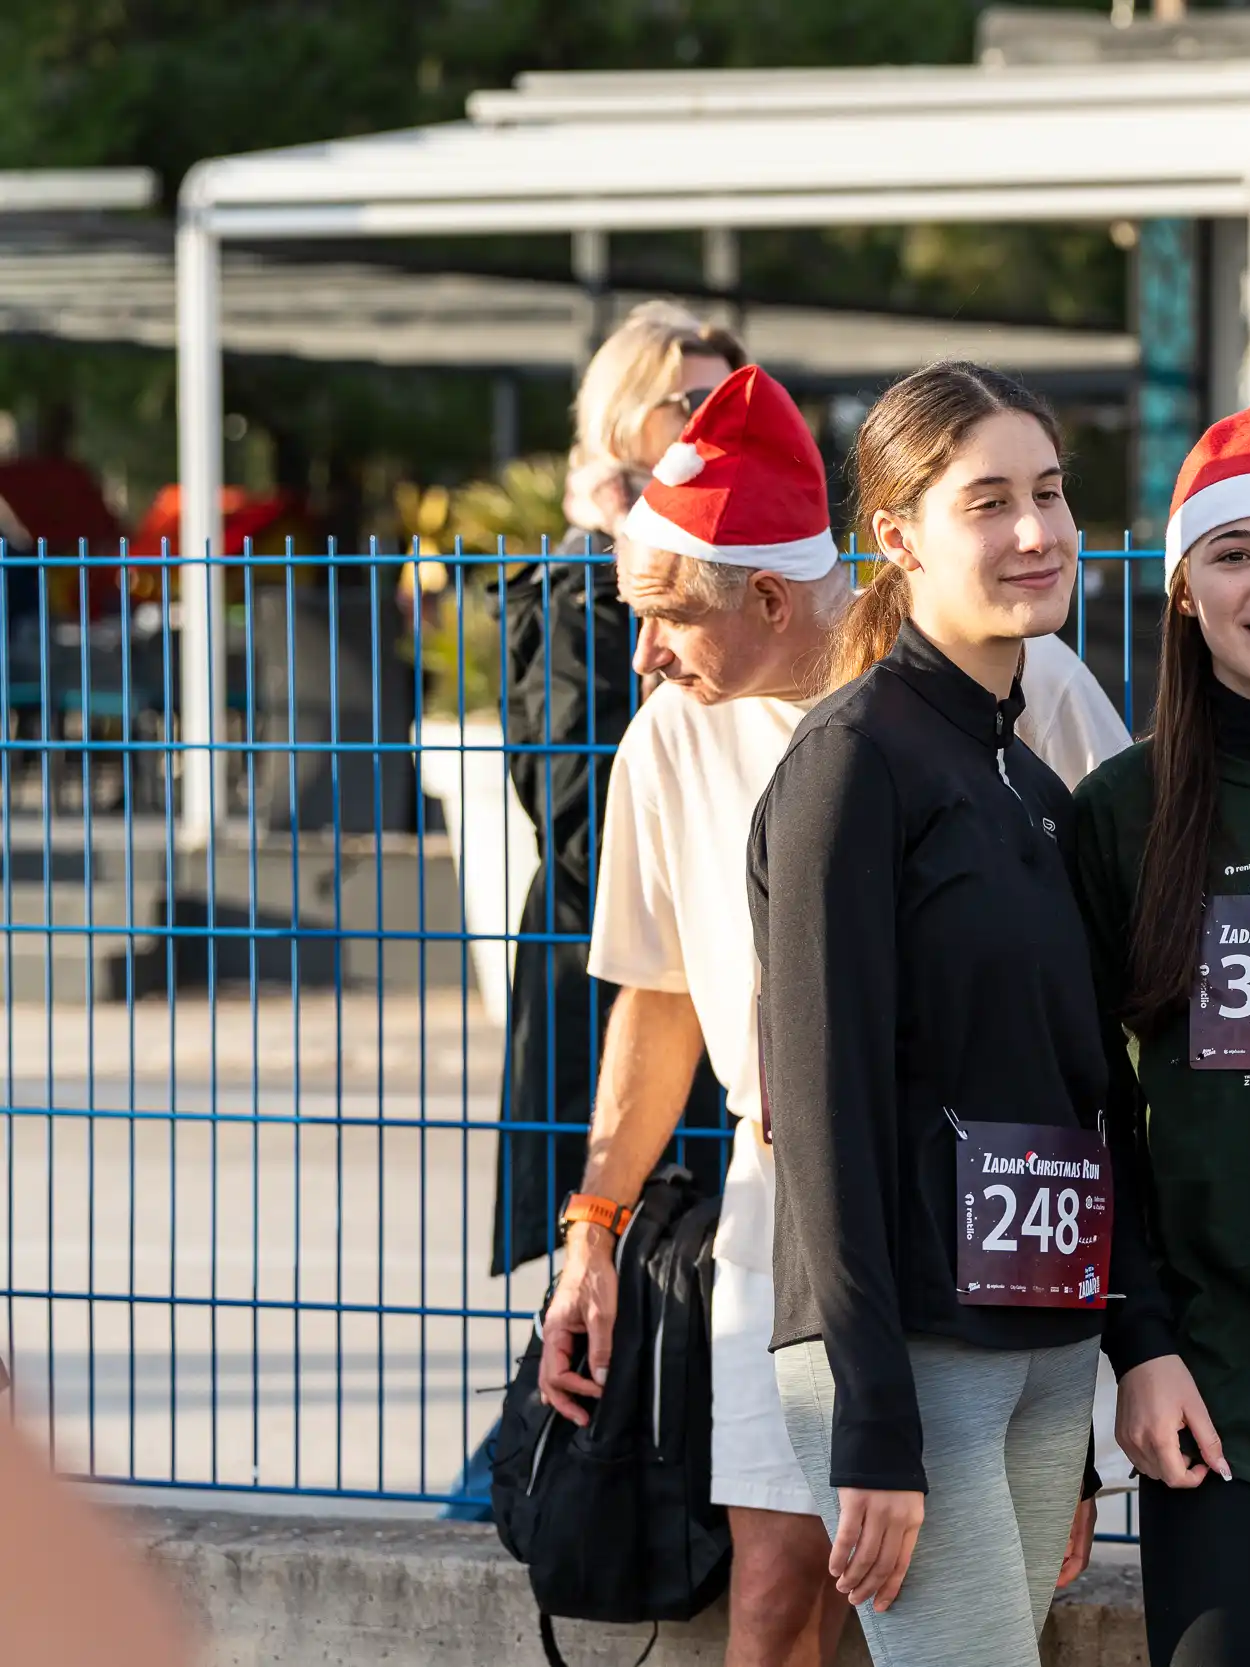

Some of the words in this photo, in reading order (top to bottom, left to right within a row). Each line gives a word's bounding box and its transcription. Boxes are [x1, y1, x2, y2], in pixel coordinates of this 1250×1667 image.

[982, 1152, 1025, 1175] ZADAR
[1029, 1156, 1081, 1180] CHRISTMAS
[1082, 1158, 1100, 1180] RUN
[966, 1207, 975, 1241] rentlio
[982, 1184, 1080, 1255] 248
